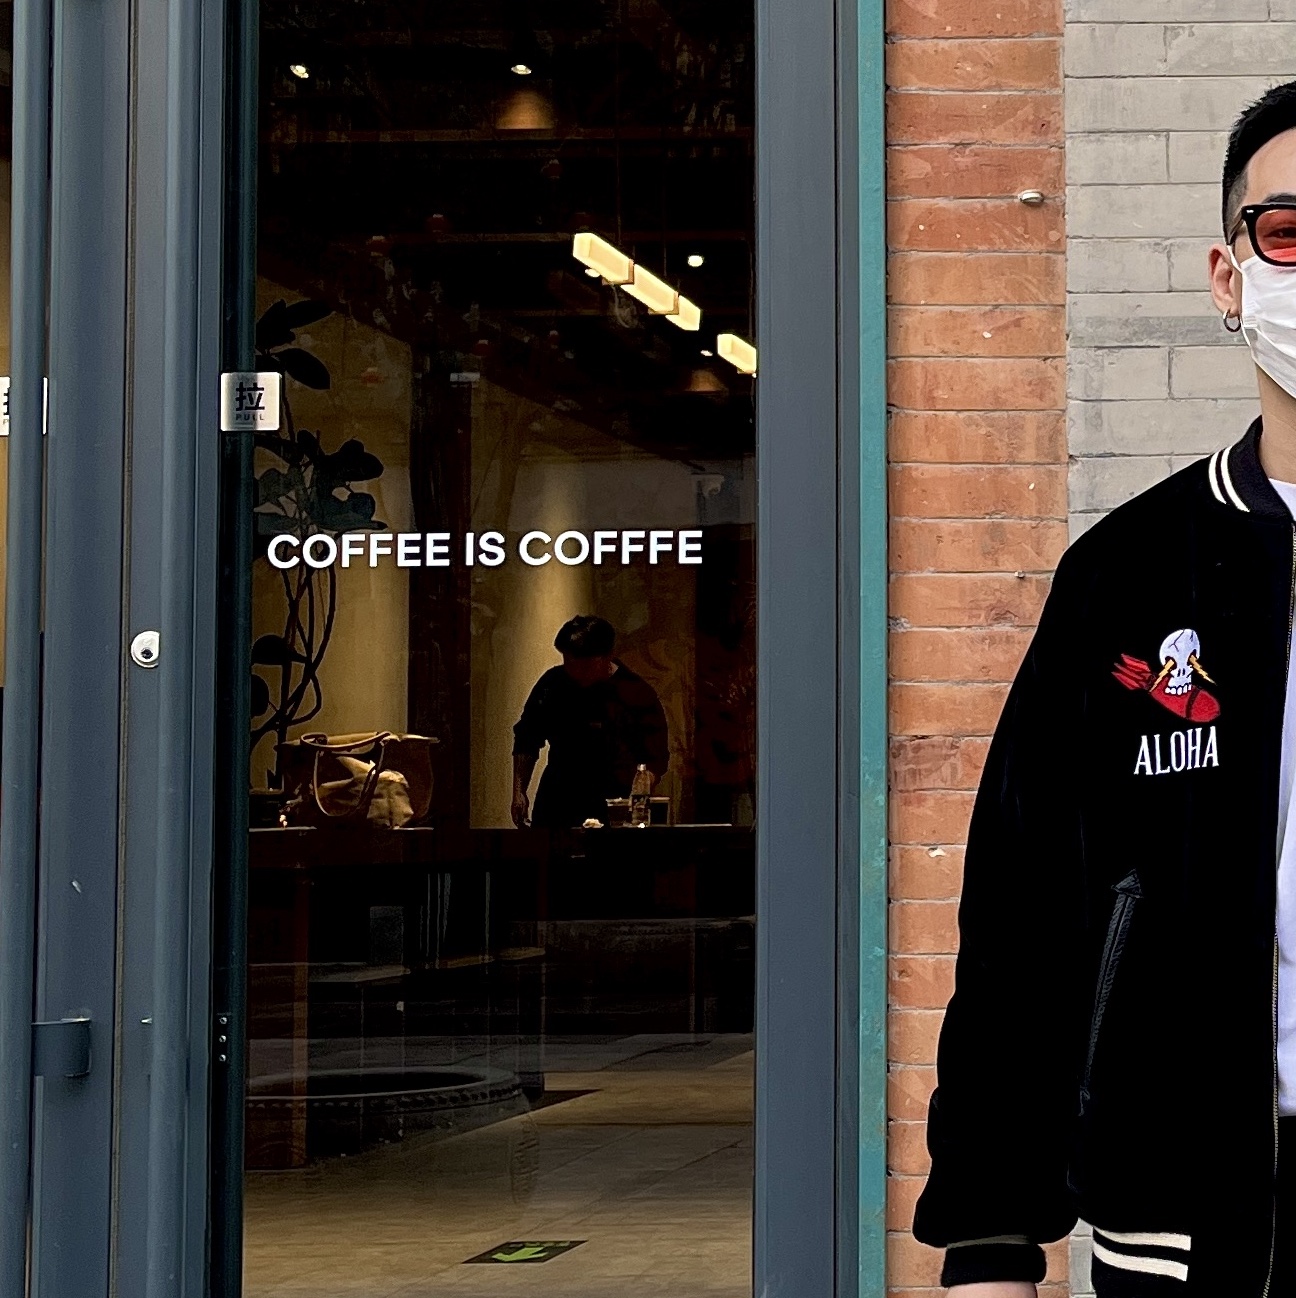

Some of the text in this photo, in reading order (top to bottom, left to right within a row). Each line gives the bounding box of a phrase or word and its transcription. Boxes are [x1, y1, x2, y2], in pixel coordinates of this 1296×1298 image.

[235, 381, 266, 412] 拉
[235, 413, 266, 422] PULL
[267, 532, 451, 570] COFFEE
[464, 530, 507, 568] IS
[1133, 725, 1220, 776] ALOHA
